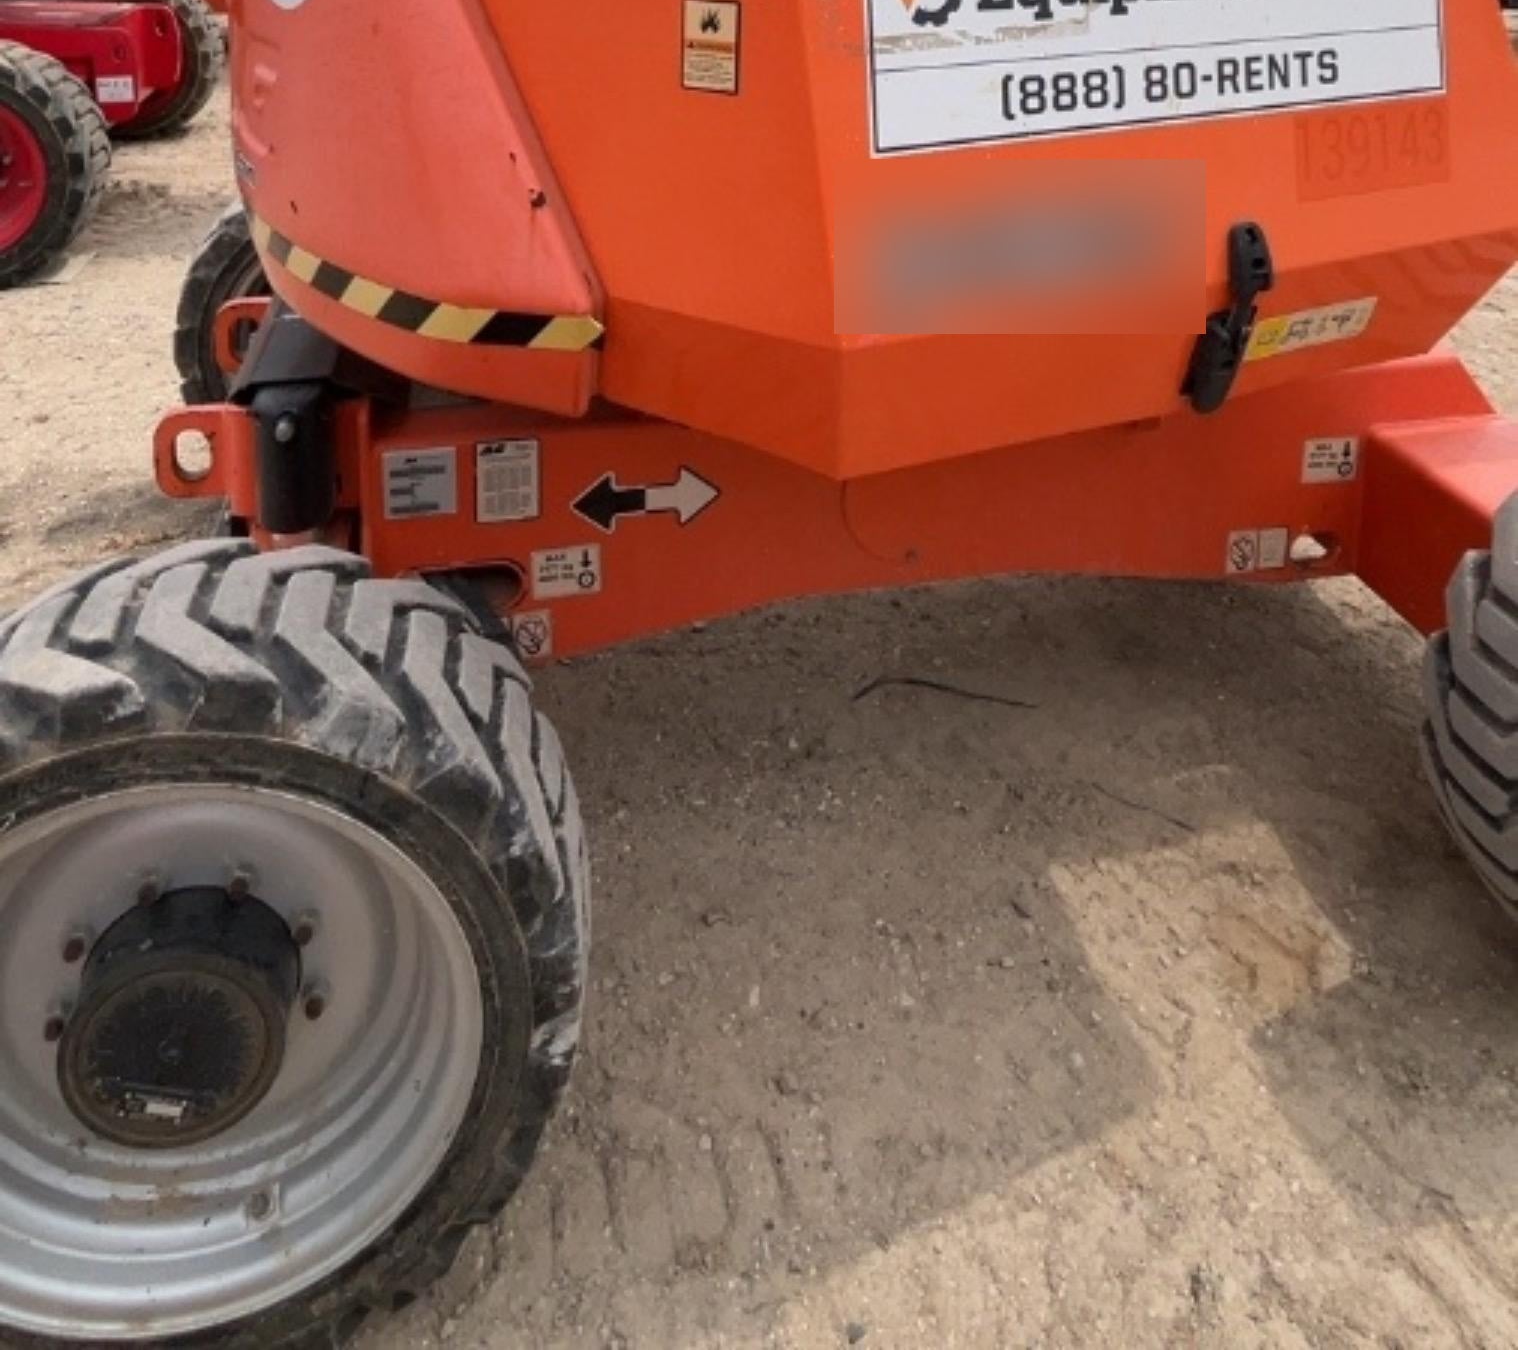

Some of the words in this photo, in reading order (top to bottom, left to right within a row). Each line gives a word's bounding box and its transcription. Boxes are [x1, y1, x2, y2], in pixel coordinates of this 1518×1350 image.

[1001, 66, 1127, 121] (888)
[1143, 49, 1340, 103] 80-RENTS
[1295, 105, 1442, 182] 139143
